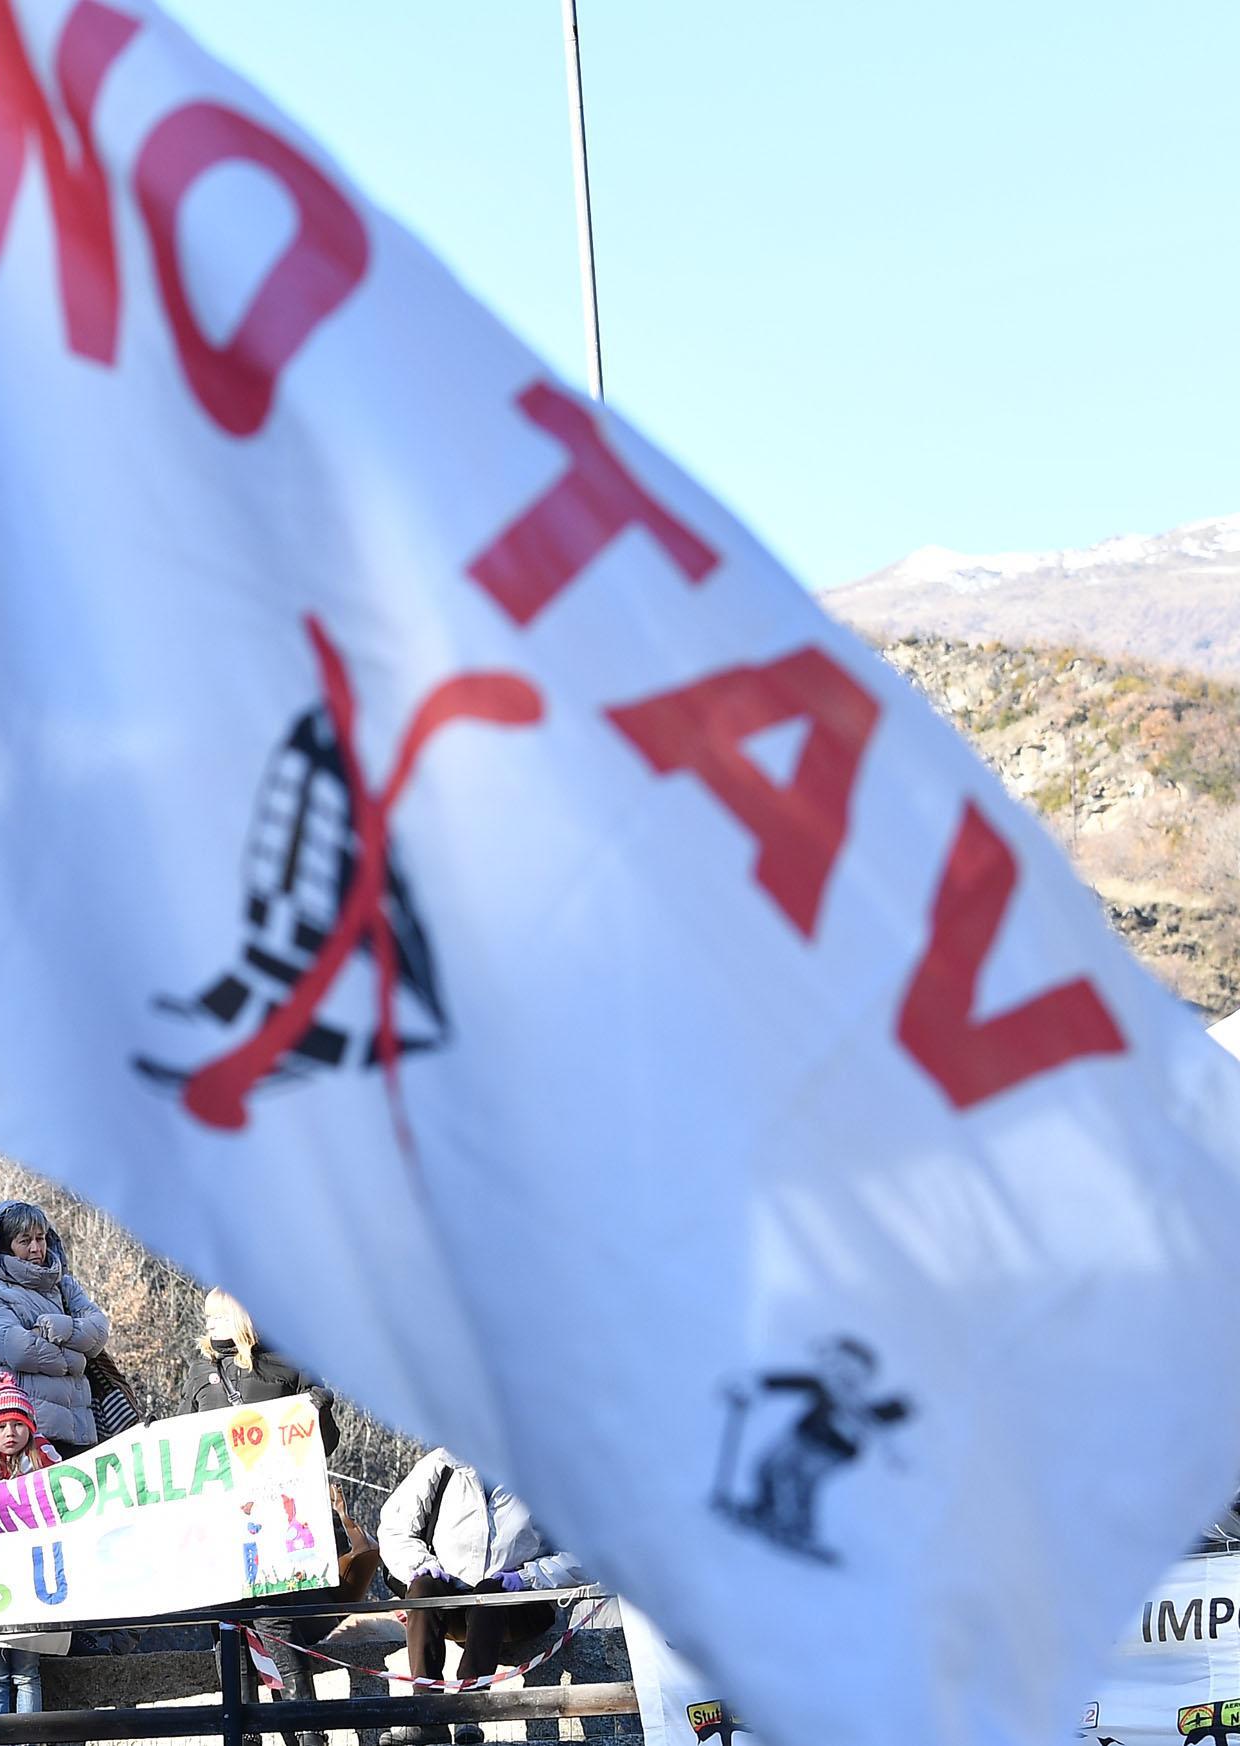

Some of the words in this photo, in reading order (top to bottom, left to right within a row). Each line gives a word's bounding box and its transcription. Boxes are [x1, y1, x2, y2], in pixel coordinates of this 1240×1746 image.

[463, 378, 1130, 1112] TAV
[231, 1426, 264, 1448] NO
[277, 1419, 316, 1447] TAV
[1142, 1597, 1240, 1643] IMP
